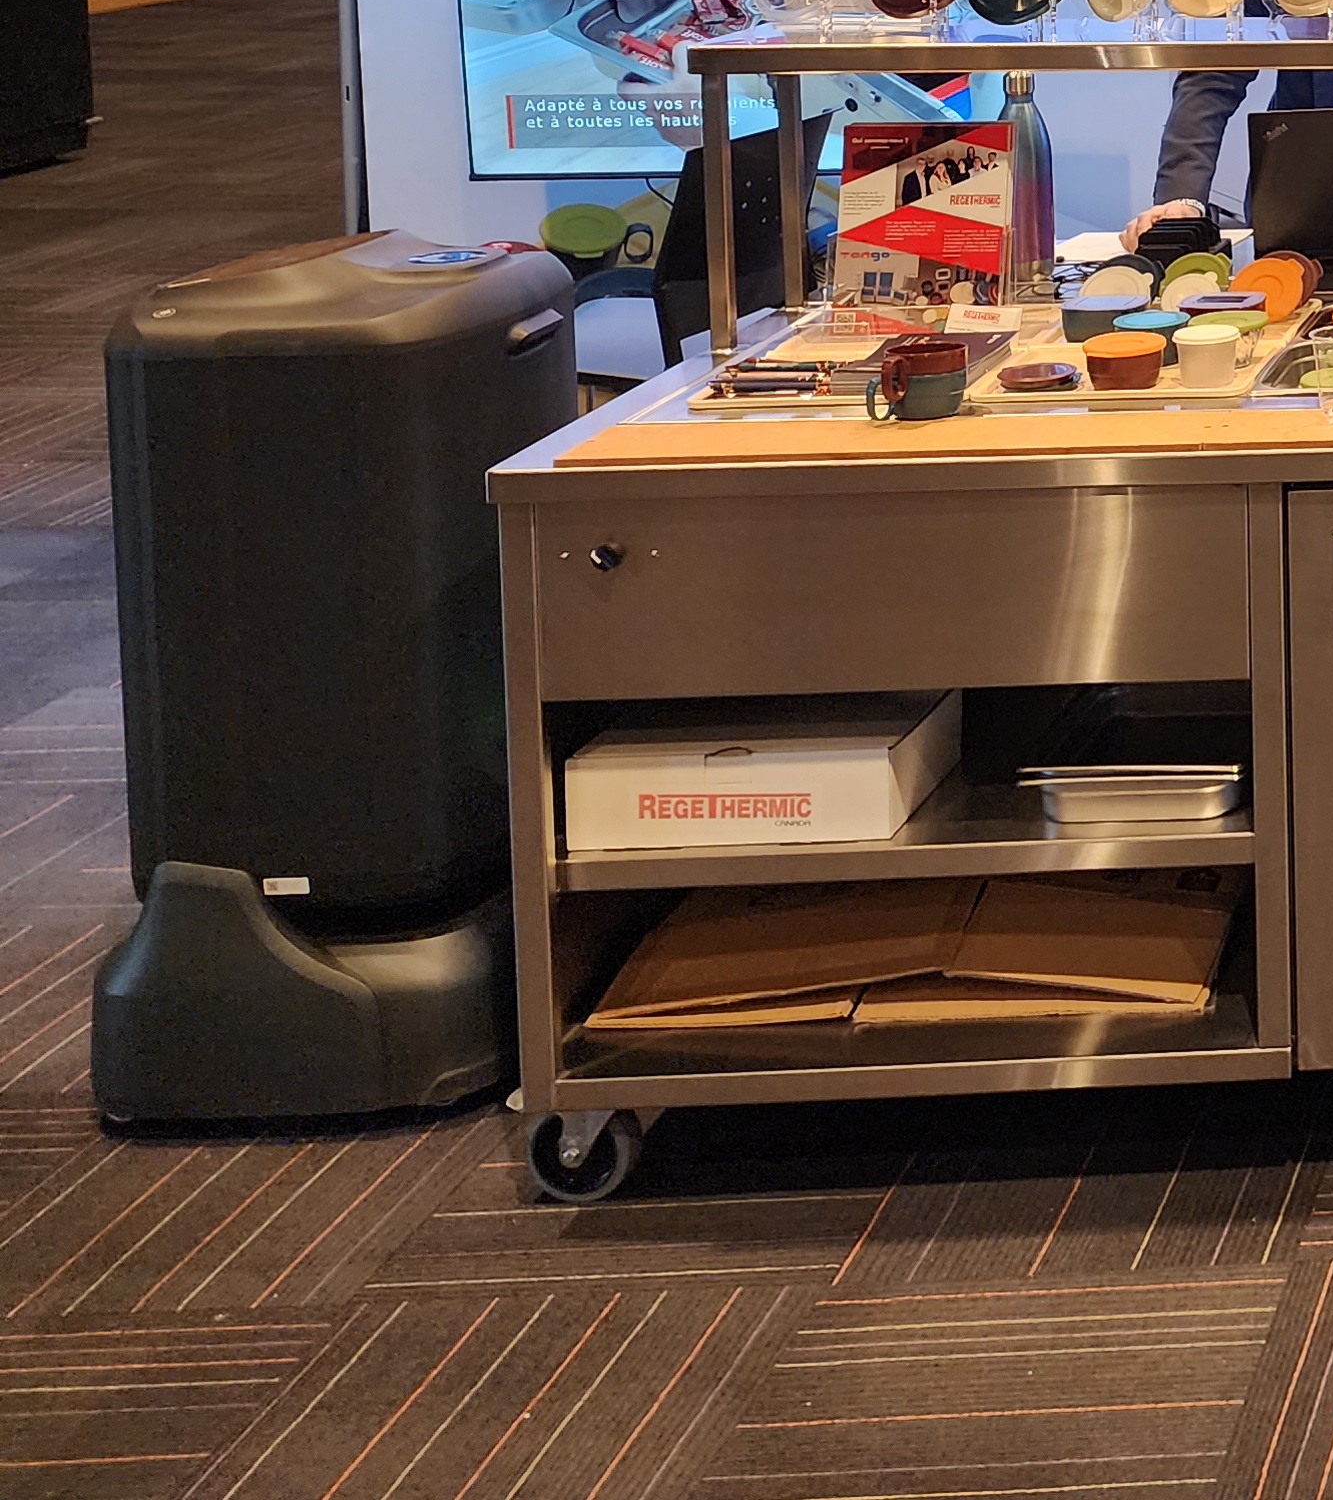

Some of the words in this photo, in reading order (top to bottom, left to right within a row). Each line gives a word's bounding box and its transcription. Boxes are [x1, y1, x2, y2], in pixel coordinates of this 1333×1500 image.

[525, 97, 586, 113] Adapté
[592, 97, 602, 110] à
[609, 98, 647, 111] tous
[653, 99, 683, 111] vos
[526, 116, 544, 128] et
[550, 114, 560, 128] à
[567, 115, 622, 128] toutes
[629, 114, 654, 127] les
[638, 793, 812, 819] REGETHERMIC
